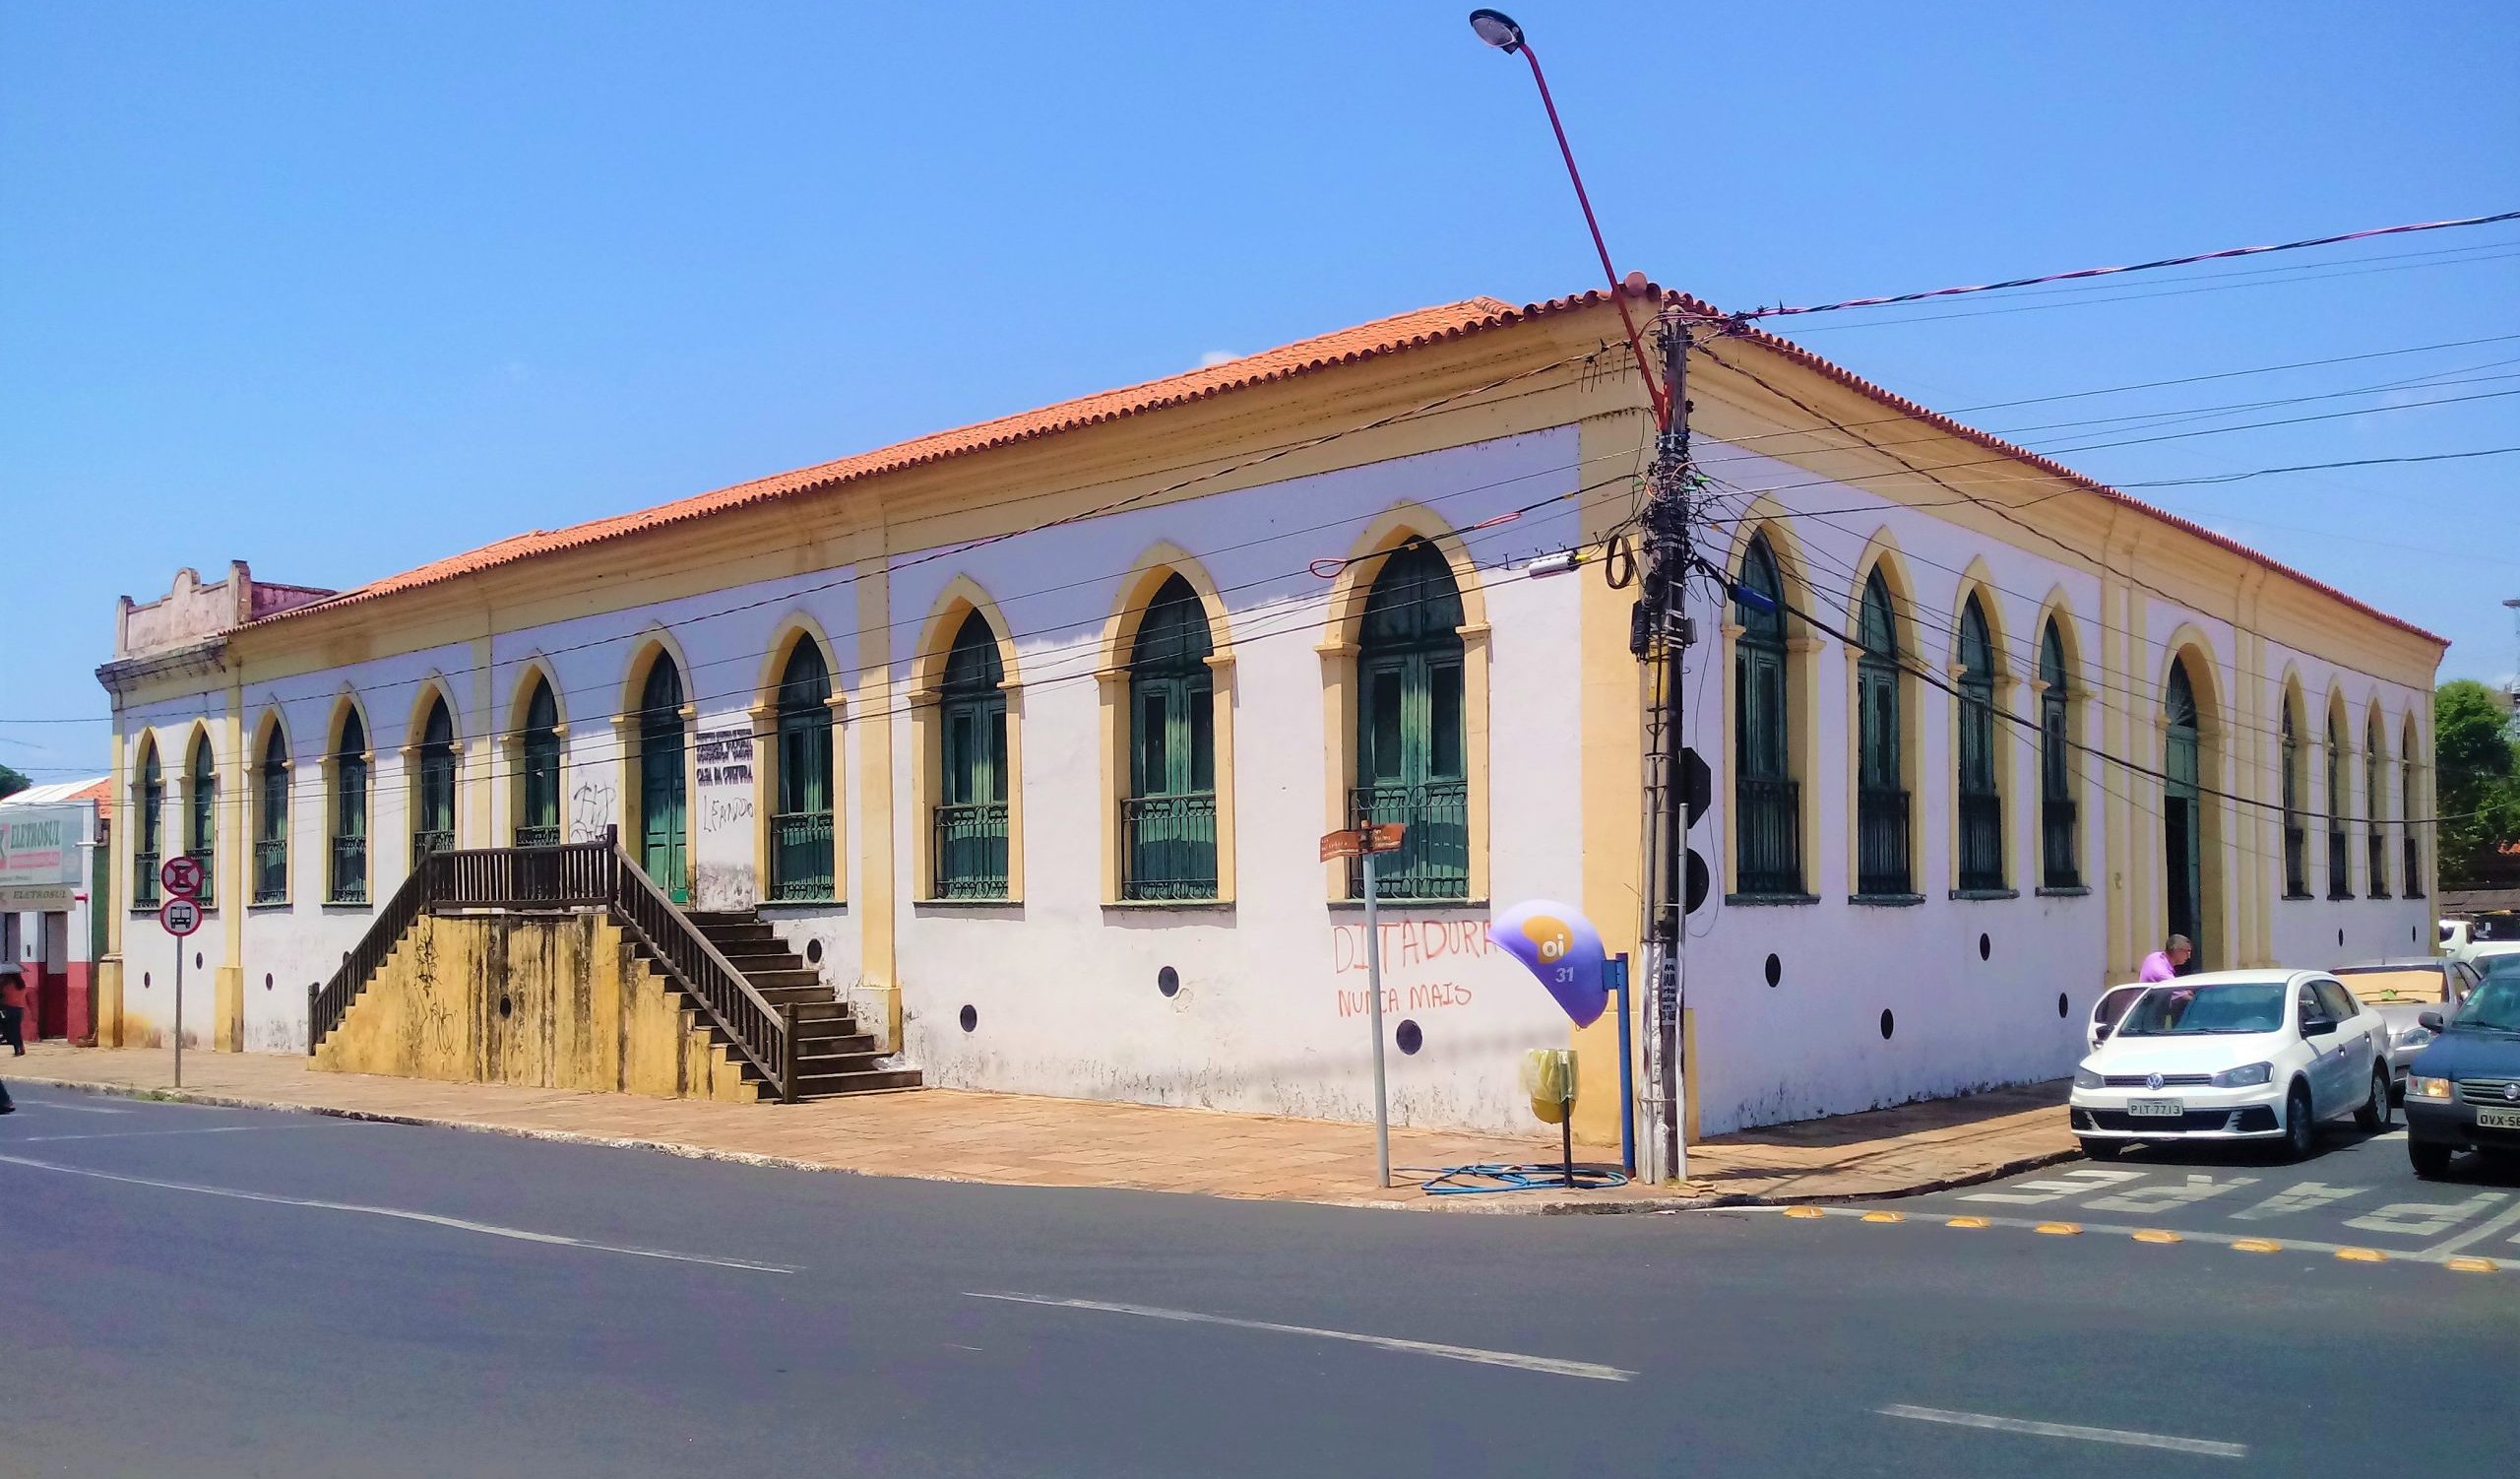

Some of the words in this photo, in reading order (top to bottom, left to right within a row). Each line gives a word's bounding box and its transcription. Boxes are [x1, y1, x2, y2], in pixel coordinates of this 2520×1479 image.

[10, 819, 61, 849] ELETROSUL
[13, 890, 67, 900] ELETROSUL
[1542, 932, 1565, 958] oi
[1554, 966, 1574, 984] 31
[1410, 982, 1473, 1010] MAIS
